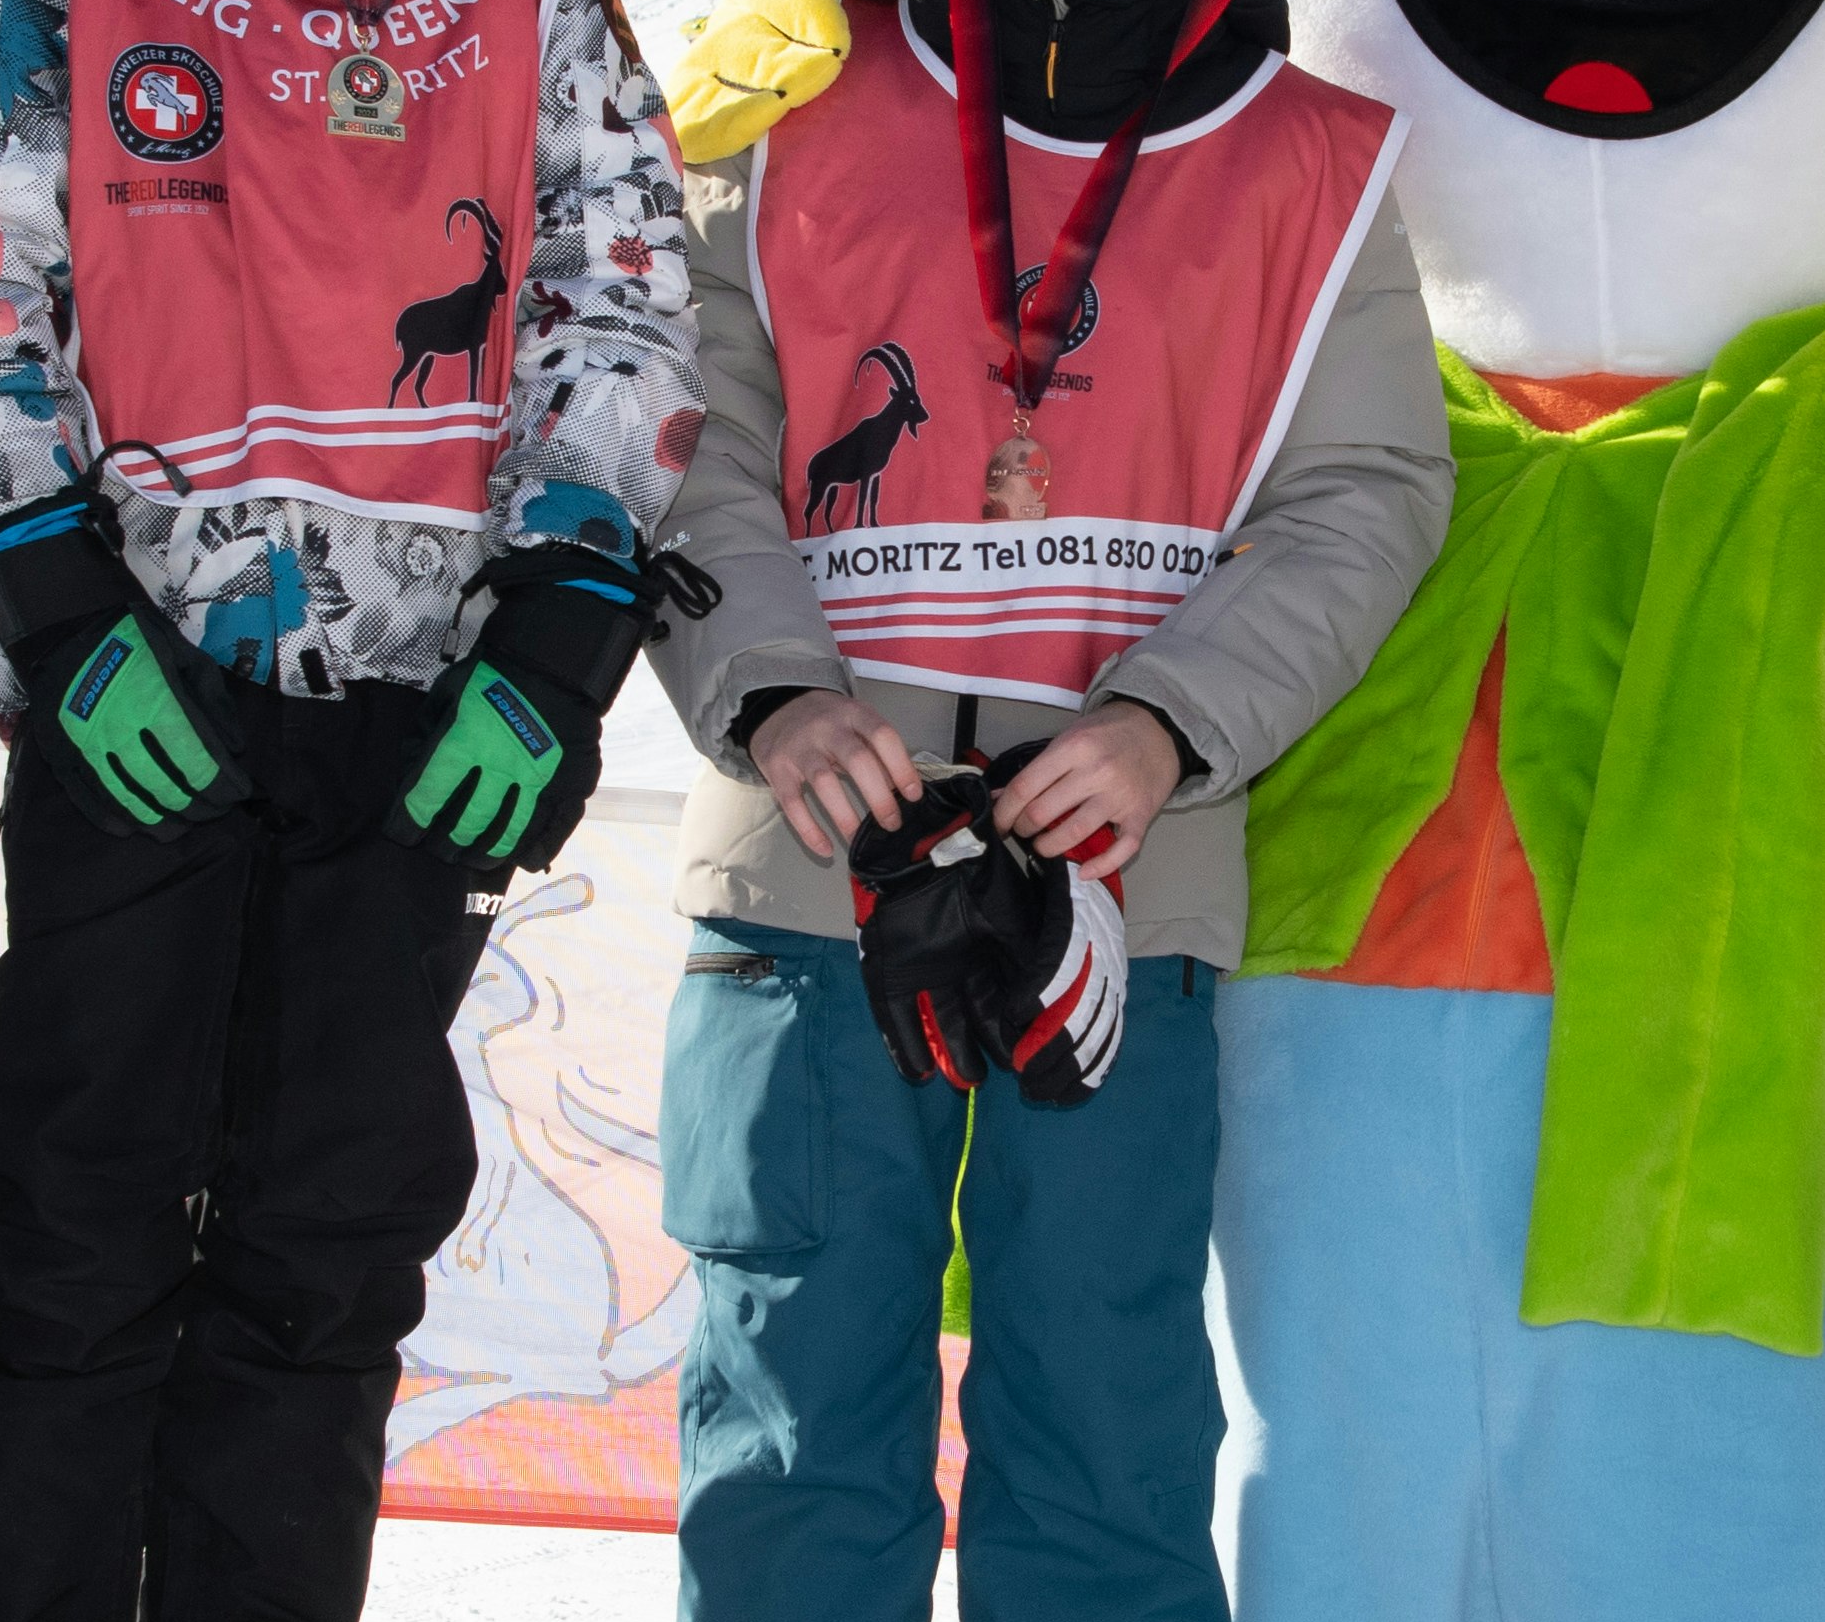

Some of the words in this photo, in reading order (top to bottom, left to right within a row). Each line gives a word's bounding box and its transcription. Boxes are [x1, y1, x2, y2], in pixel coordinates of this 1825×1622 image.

[112, 49, 166, 101] SCHWEIZER
[171, 50, 224, 113] SKISCHULE
[269, 69, 326, 104] ST.
[403, 34, 489, 100] RITZ
[827, 541, 962, 579] MORITZ
[973, 539, 1027, 571] Tel
[1036, 535, 1098, 566] 081
[1106, 538, 1155, 570] 830
[81, 647, 124, 716] ziener
[488, 692, 543, 750] ziener
